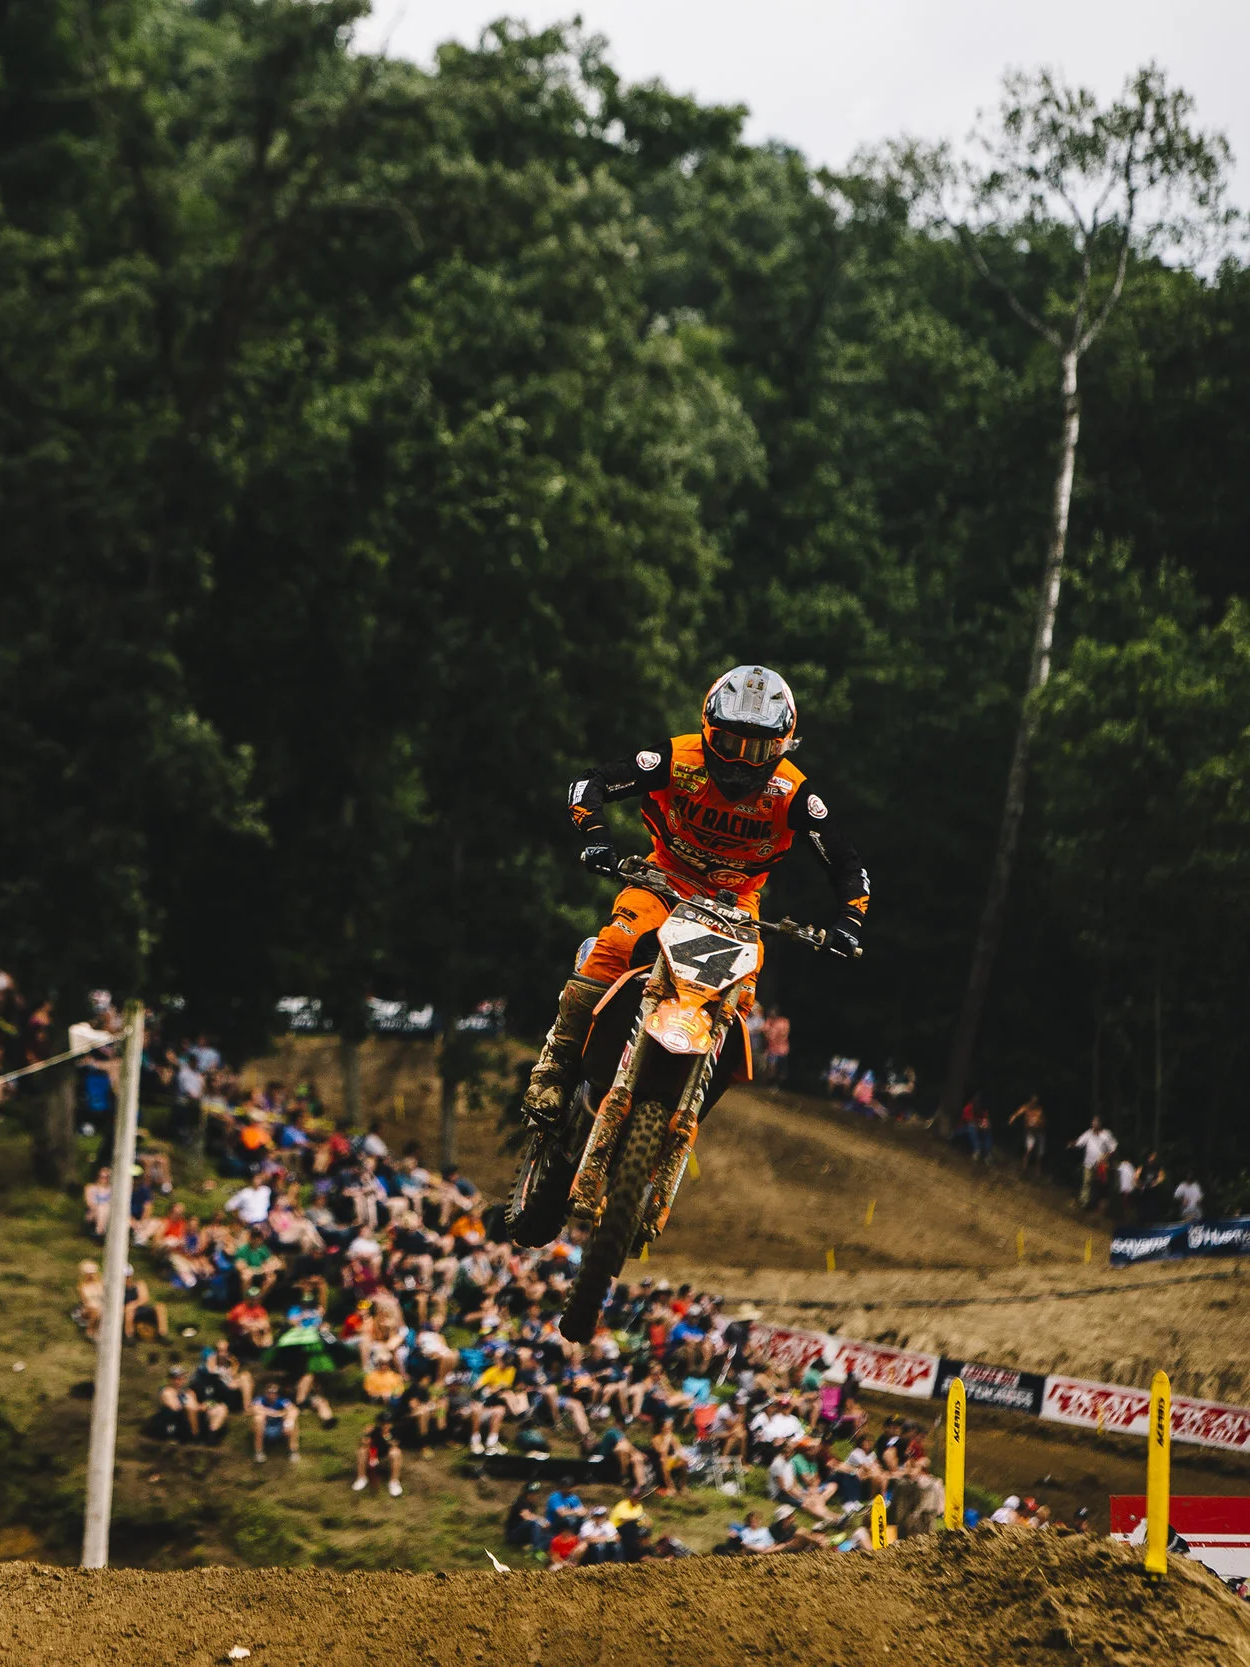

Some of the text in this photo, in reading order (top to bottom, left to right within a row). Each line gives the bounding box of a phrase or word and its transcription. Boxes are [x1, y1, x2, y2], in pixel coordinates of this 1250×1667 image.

[702, 806, 774, 841] RACING
[697, 914, 723, 929] LUCAS
[669, 934, 744, 988] 4
[953, 1400, 961, 1443] ACERBIS
[1157, 1396, 1166, 1448] ACERBIS
